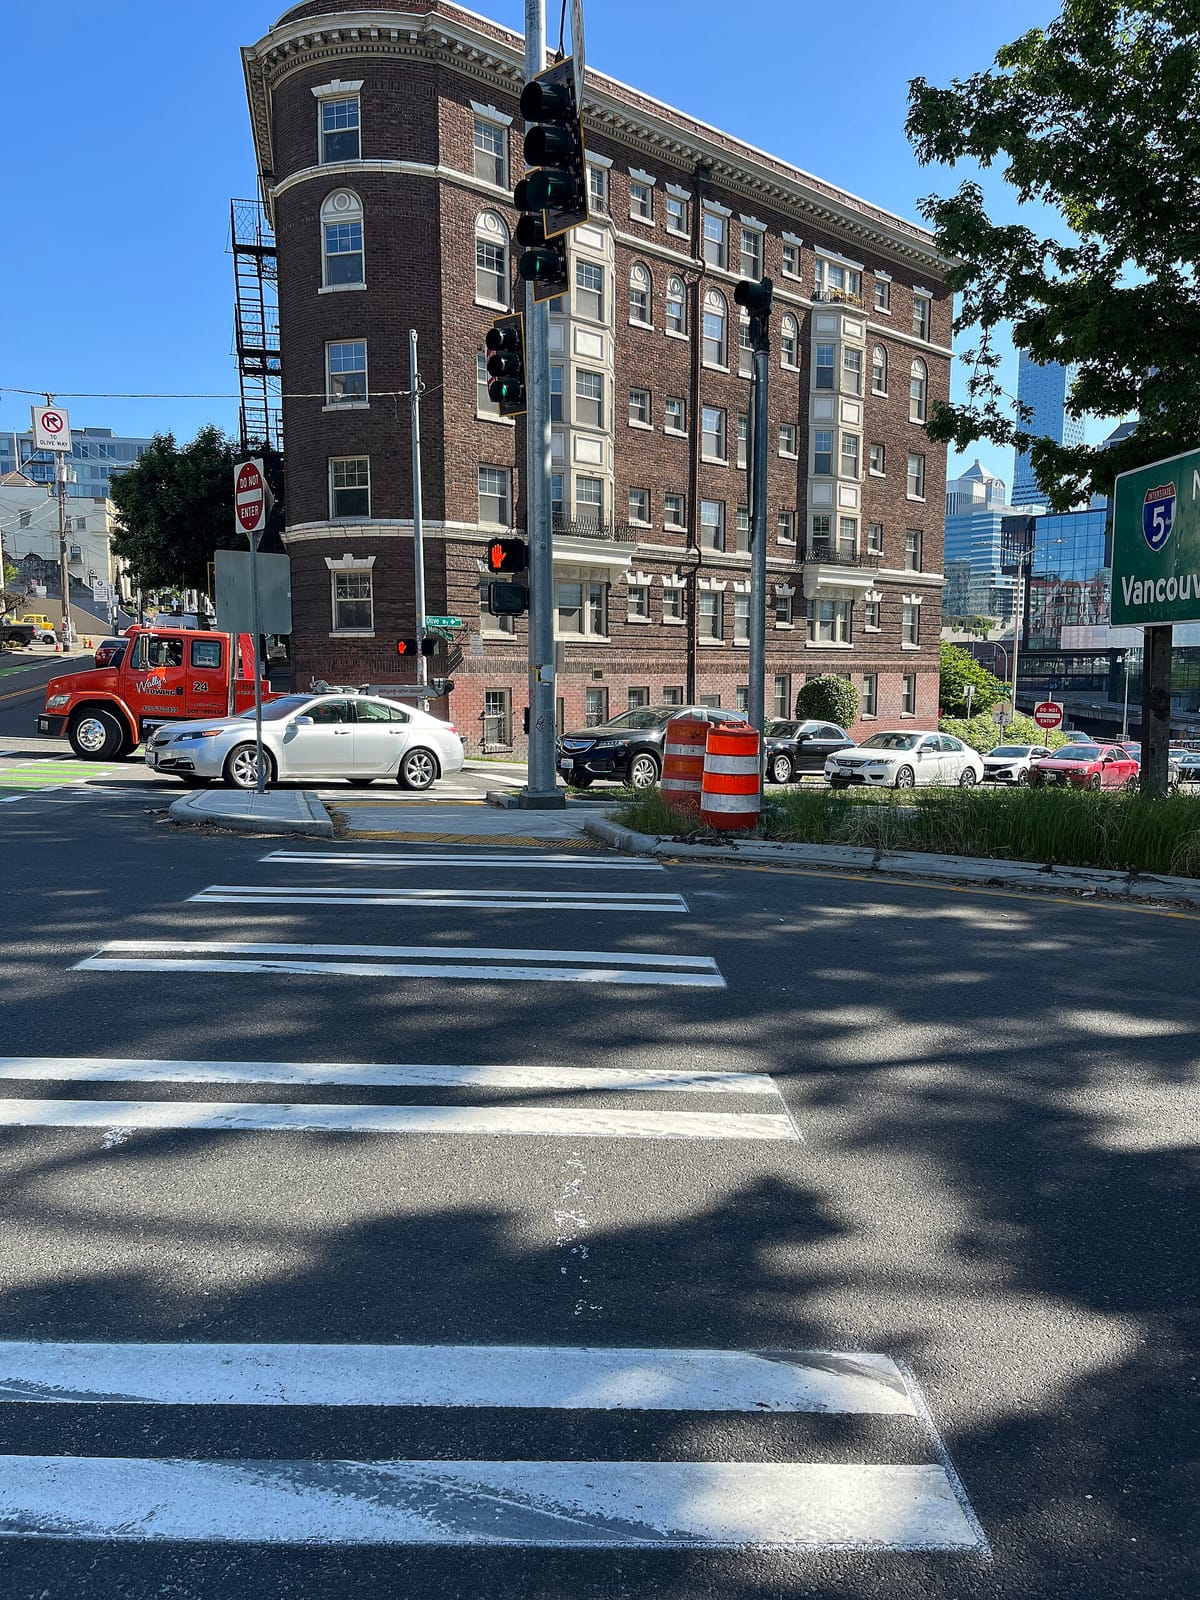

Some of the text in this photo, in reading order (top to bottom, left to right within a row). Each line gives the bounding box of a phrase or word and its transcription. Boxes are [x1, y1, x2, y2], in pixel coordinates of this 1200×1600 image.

[240, 474, 259, 489] DO NOT
[1147, 485, 1172, 500] INTERSTATE
[241, 505, 259, 519] ENTER
[1152, 506, 1165, 543] 5
[146, 688, 176, 696] TOWING
[193, 681, 208, 693] 24
